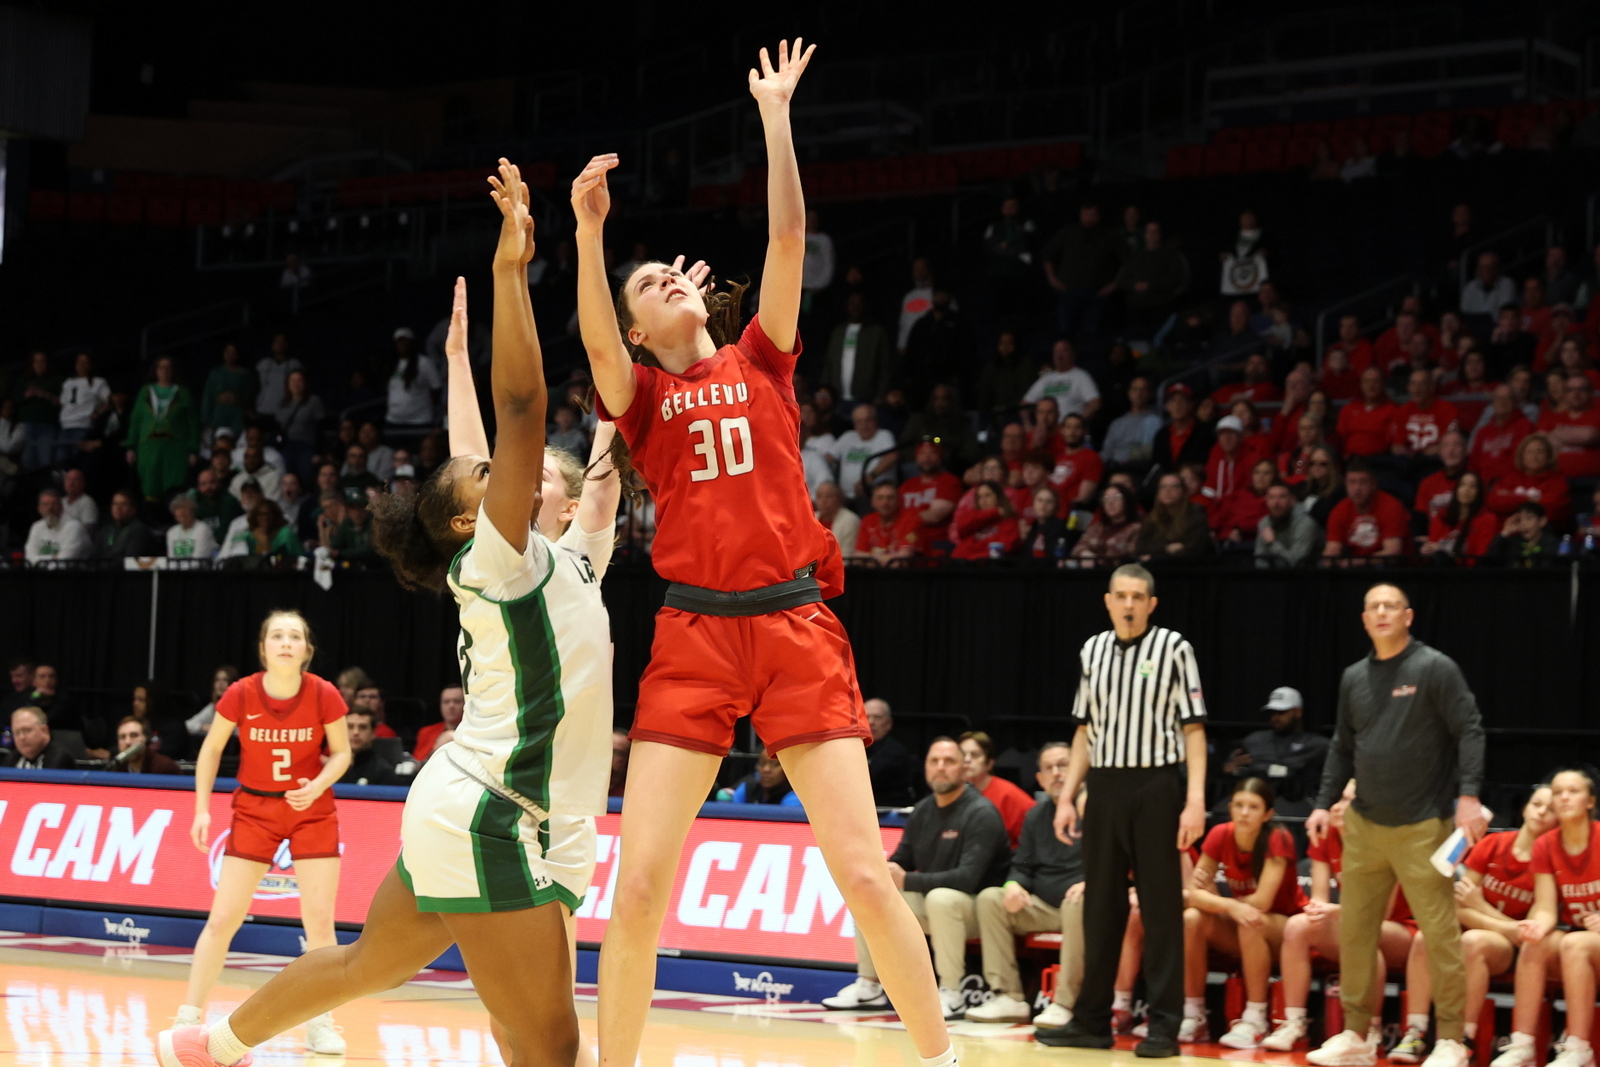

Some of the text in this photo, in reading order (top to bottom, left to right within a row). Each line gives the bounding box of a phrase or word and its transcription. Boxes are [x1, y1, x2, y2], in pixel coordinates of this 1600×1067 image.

[661, 382, 749, 422] BELLEVU
[687, 416, 754, 482] 30
[249, 727, 314, 743] BELLEVUE
[271, 748, 292, 782] 2
[11, 802, 173, 885] CAM
[677, 841, 856, 937] CAM
[751, 971, 794, 1001] Kroger
